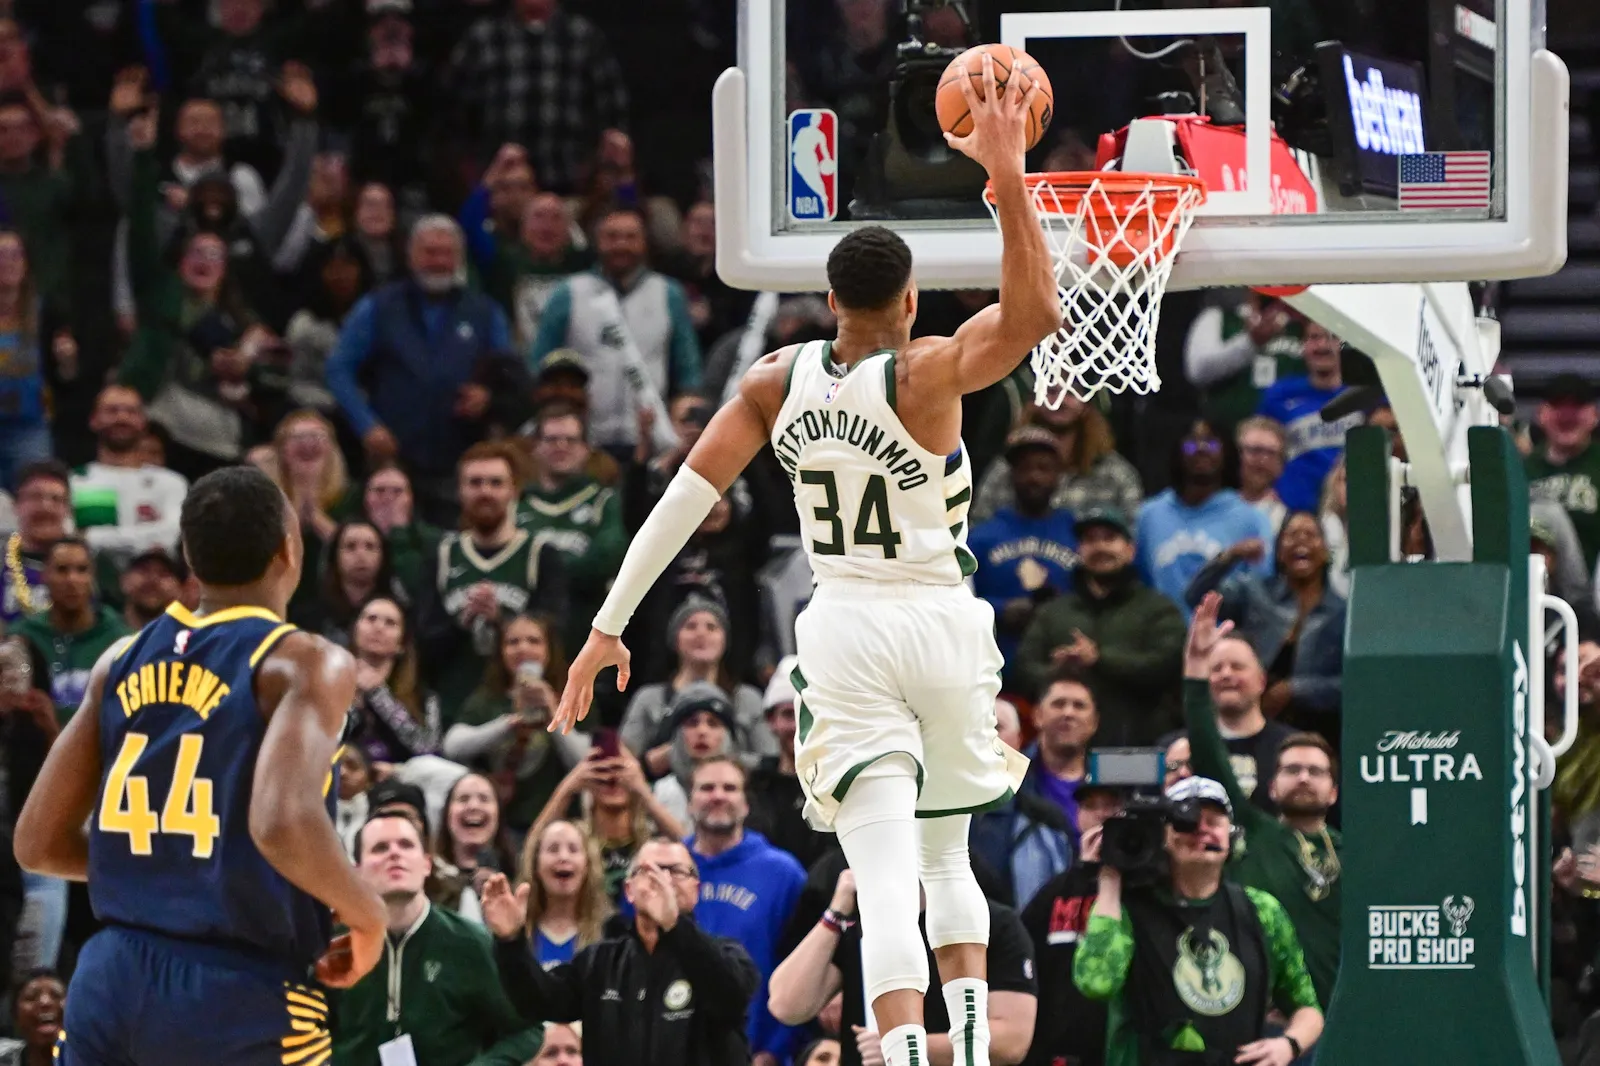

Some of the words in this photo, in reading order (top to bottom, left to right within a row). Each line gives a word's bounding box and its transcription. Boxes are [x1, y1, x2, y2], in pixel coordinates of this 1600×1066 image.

[796, 196, 819, 214] NBA
[799, 470, 902, 559] 34
[1377, 730, 1462, 752] Michelob
[1360, 752, 1484, 783] ULTRA
[98, 732, 220, 859] 44
[1510, 638, 1528, 937] betway
[1368, 911, 1440, 937] BUCKS
[1368, 938, 1412, 964] PRO
[1417, 938, 1475, 964] SHOP
